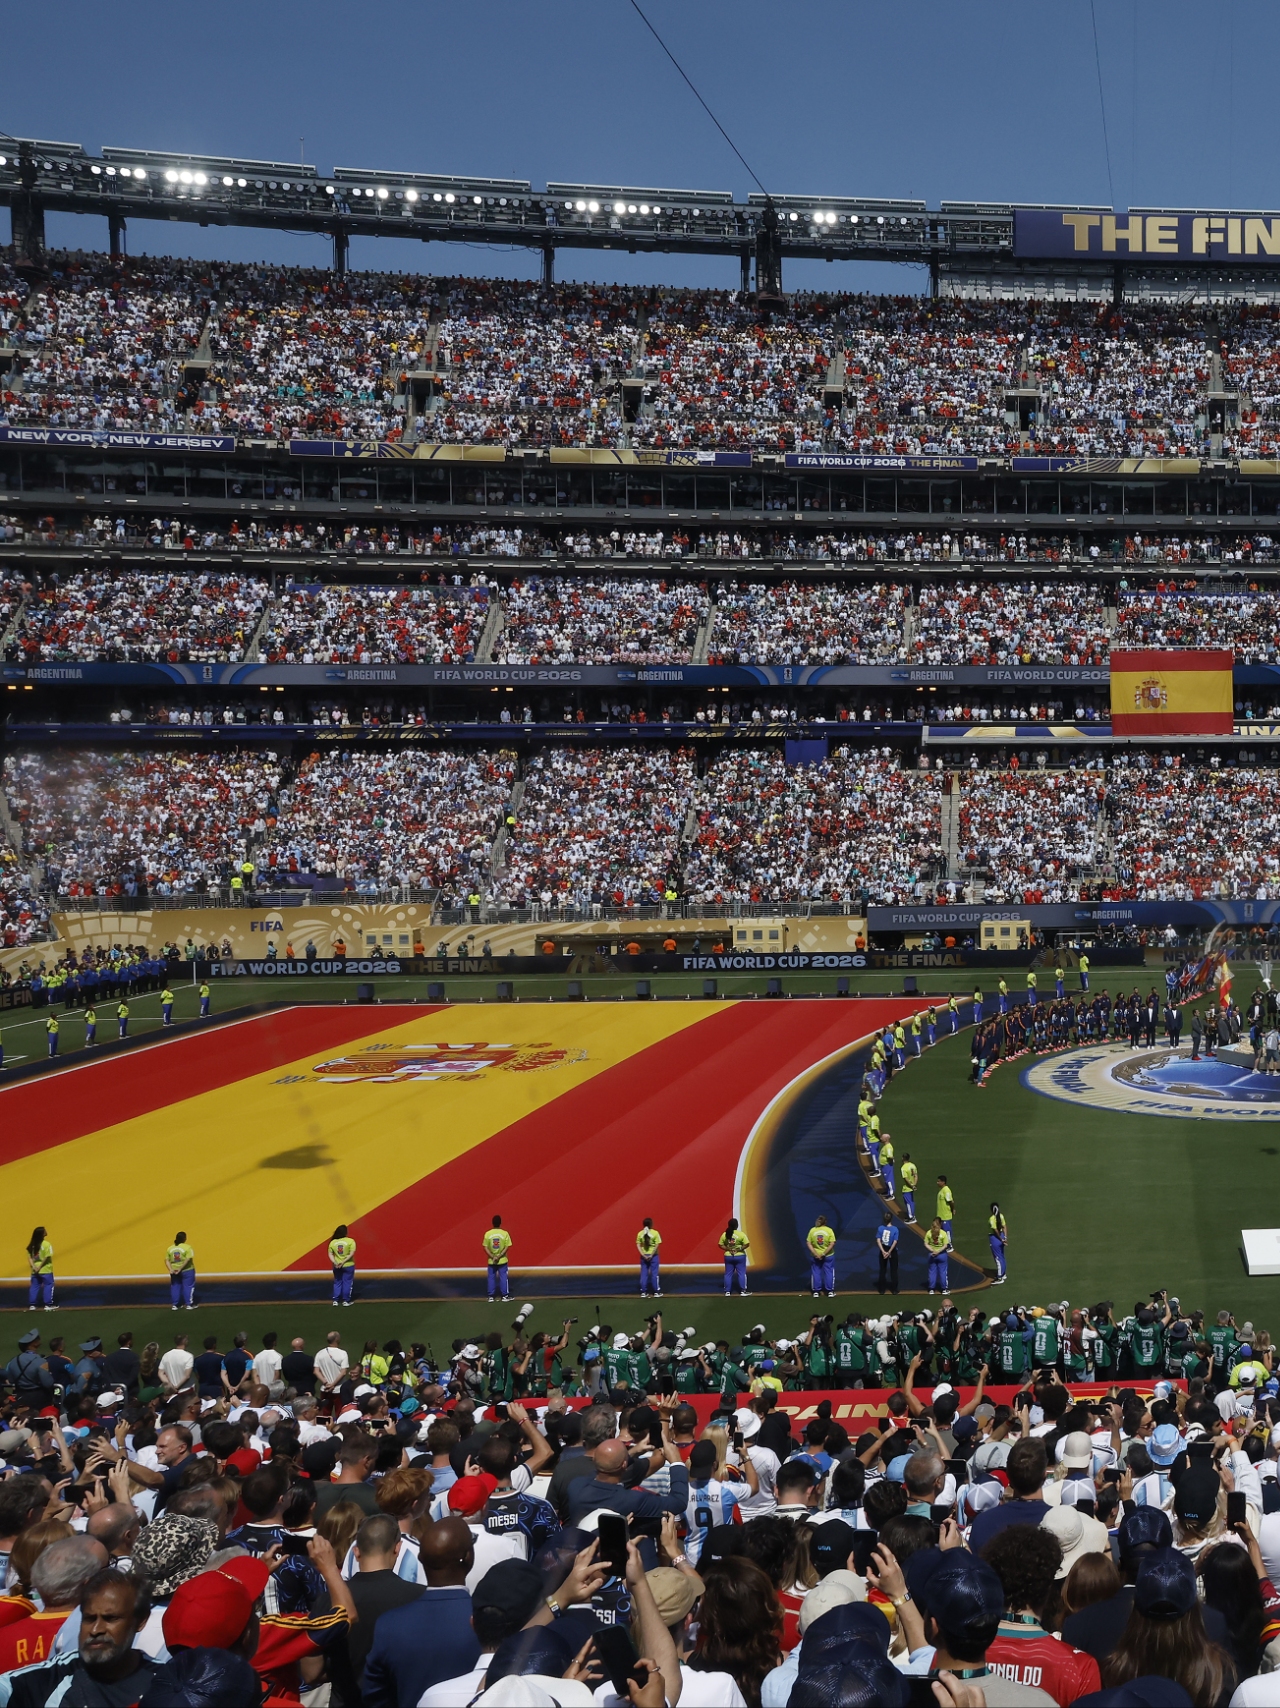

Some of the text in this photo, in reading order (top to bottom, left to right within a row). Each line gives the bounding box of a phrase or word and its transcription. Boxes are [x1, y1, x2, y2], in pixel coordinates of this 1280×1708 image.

[1062, 214, 1179, 254] THE
[8, 430, 225, 450] NEW YOR NEW JERSEY
[797, 456, 906, 468] FIFA WORLD CUP 2026
[909, 458, 965, 469] THE FINAL
[27, 668, 83, 680] ARGENTINA
[347, 669, 397, 681] ARGENTINA
[434, 669, 582, 681] FIFA WORLD CUP 2026
[637, 670, 683, 681] ARGENTINA
[910, 670, 954, 681] ARGENTINA
[987, 670, 1110, 681] FIFA WORLD CUP 202
[892, 912, 1020, 924] FIFA WORLD CUP 2026
[1092, 909, 1133, 920] ARGENTINA
[250, 919, 284, 933] FIFA
[683, 954, 867, 970] FIFA WORLD CUP 2026
[872, 953, 967, 968] THE FINAL
[1163, 950, 1198, 962] NEW
[211, 960, 400, 977] FIFA WORLD CUP 2026
[407, 960, 503, 974] THE FINAL
[13, 990, 32, 1005] FIN
[1050, 1055, 1107, 1093] THE FINAL
[1127, 1100, 1193, 1112] FIFA
[775, 1403, 890, 1420] PAIN
[689, 1492, 720, 1503] .ÁLVAREZ
[488, 1513, 519, 1528] MESSI
[694, 1507, 714, 1528] 9
[594, 1609, 616, 1625] SSI
[16, 1635, 44, 1664] RA
[986, 1662, 1043, 1687] ONALDO
